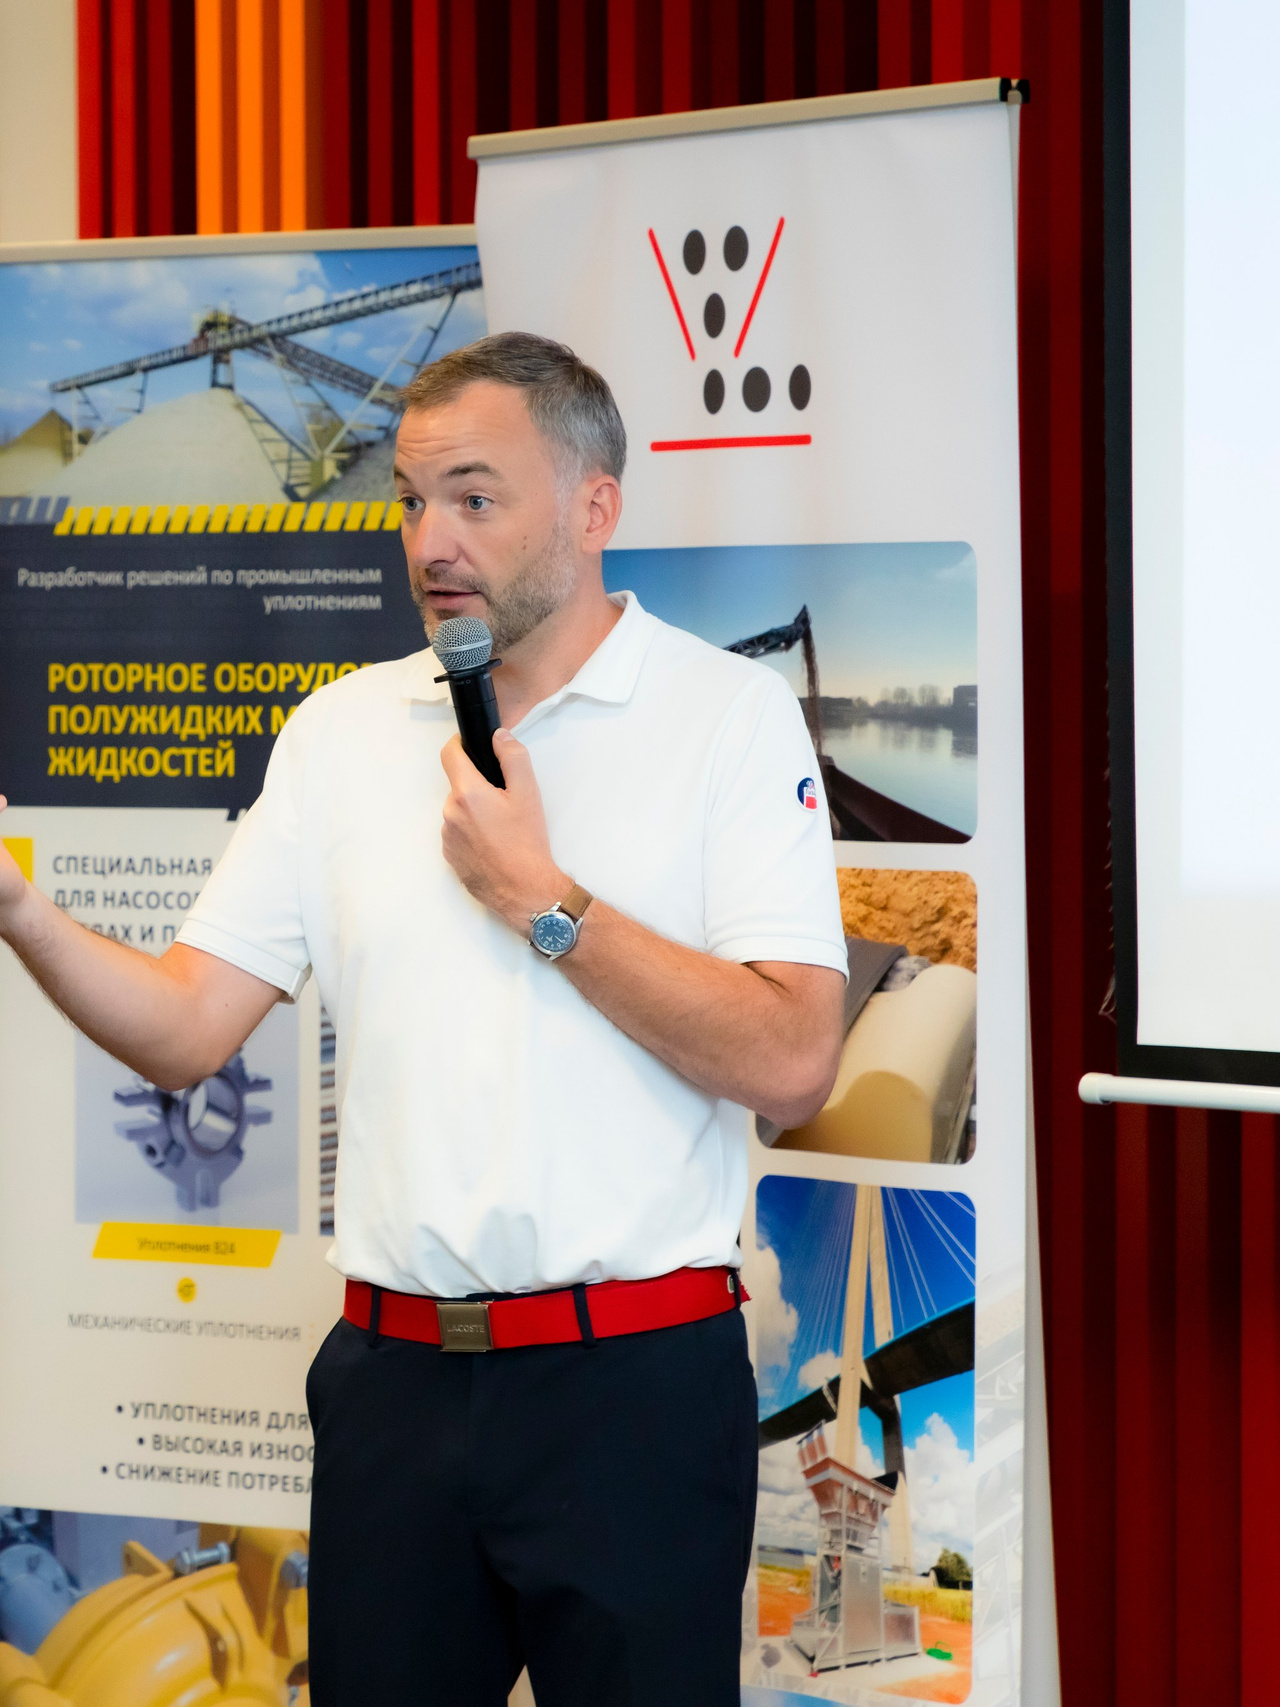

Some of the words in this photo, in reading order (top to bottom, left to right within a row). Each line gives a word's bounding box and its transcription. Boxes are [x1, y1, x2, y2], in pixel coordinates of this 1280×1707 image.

[18, 567, 124, 591] Разработчик
[127, 565, 207, 589] решений
[211, 569, 233, 586] по
[236, 568, 381, 588] промышленным
[263, 594, 381, 614] уплотнениям
[48, 662, 207, 693] РОТОРНОЕ
[214, 661, 375, 693] ОБОРУД
[48, 704, 263, 741] ПОЛУЖИДКИХ
[47, 740, 236, 783] ЖИДКОСТЕЙ
[53, 855, 213, 879] СПЕЦИАЛЬНАЯ
[54, 889, 95, 909] ДЛЯ
[103, 890, 200, 910] НАСОСО
[141, 925, 154, 943] И
[68, 1313, 192, 1336] МЕХАНИЧЕСКИЕ
[195, 1319, 301, 1342] УПЛОТНЕНИЯ
[447, 1324, 485, 1333] LACOSTE
[130, 1402, 260, 1427] УПЛОТНЕНИЯ
[265, 1411, 310, 1433] ДЛЯ
[152, 1434, 243, 1458] ВЫСОКАЯ
[116, 1461, 222, 1488] СНИЖЕНИЕ
